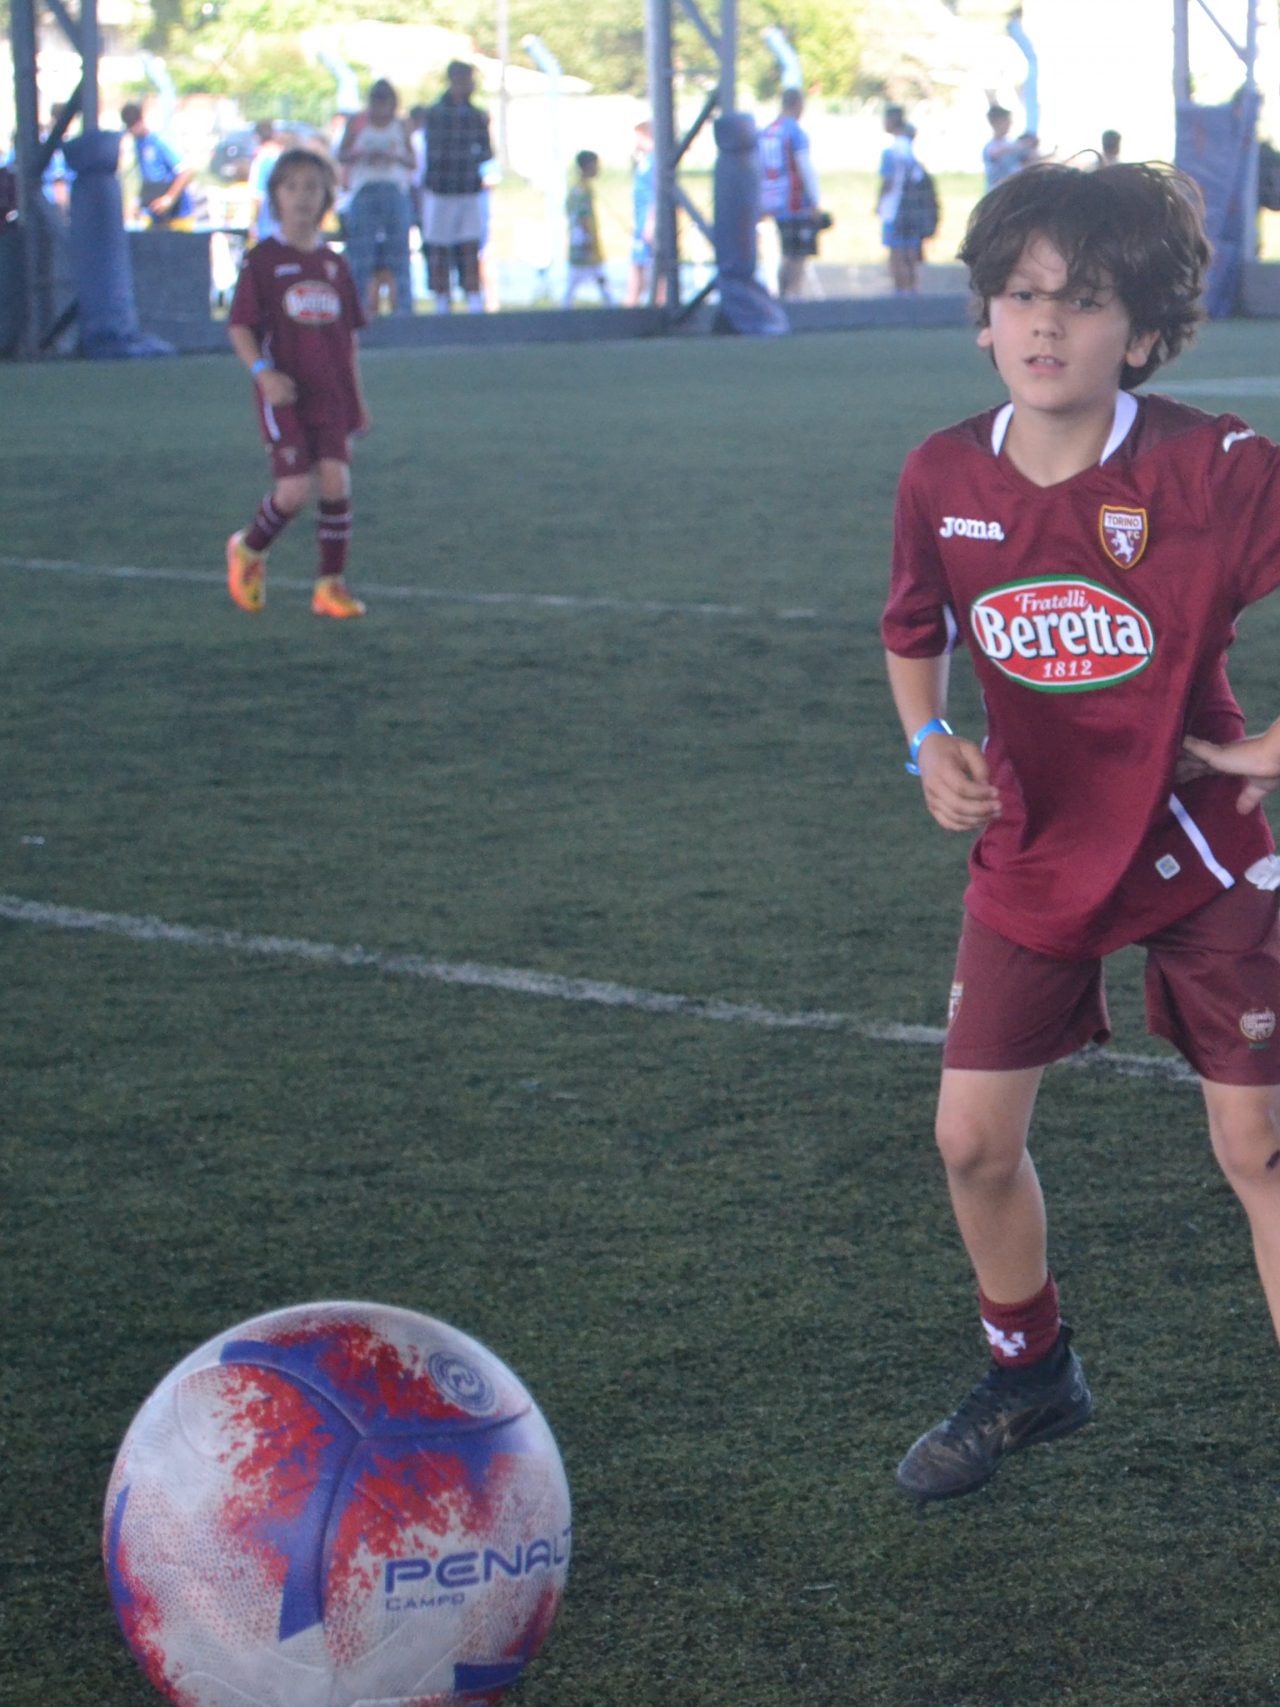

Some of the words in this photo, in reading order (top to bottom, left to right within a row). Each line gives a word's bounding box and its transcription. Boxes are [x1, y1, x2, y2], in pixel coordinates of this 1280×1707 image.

[1107, 515, 1139, 527] TORINO
[1126, 530, 1141, 540] FC
[1014, 589, 1089, 613] Fratelli
[974, 604, 1150, 660] Beretta
[1042, 659, 1093, 678] 1812
[385, 1592, 465, 1612] CAMPO
